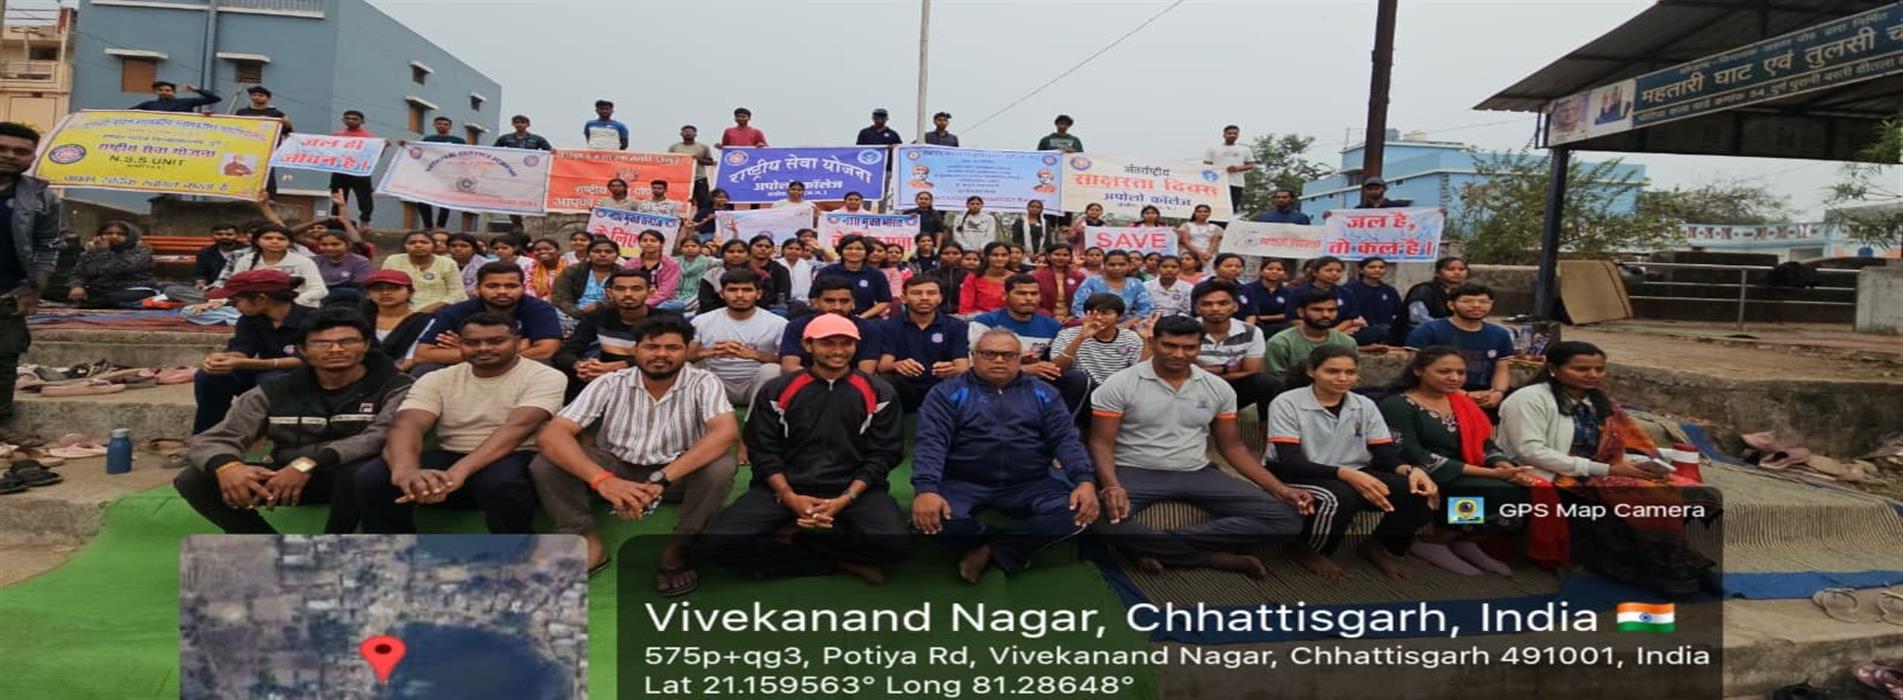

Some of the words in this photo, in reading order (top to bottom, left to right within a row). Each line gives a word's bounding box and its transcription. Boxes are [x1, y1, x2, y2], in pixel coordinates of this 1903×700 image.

[1642, 71, 1706, 103] महतारी
[1713, 63, 1754, 85] घाट
[1764, 48, 1794, 77] एवं
[1804, 26, 1877, 69] तुलसी
[152, 158, 186, 166] UNIT
[728, 158, 782, 184] राष्ट्रीय
[784, 153, 817, 170] सेवा
[822, 155, 873, 184] योजना
[1073, 173, 1155, 191] साक्षरता
[1162, 177, 1218, 197] दिवस
[1103, 191, 1145, 203] अपोलो
[1346, 214, 1386, 229] जल
[1096, 232, 1168, 249] SAVE
[1328, 238, 1352, 254] तो
[1357, 240, 1398, 256] कल
